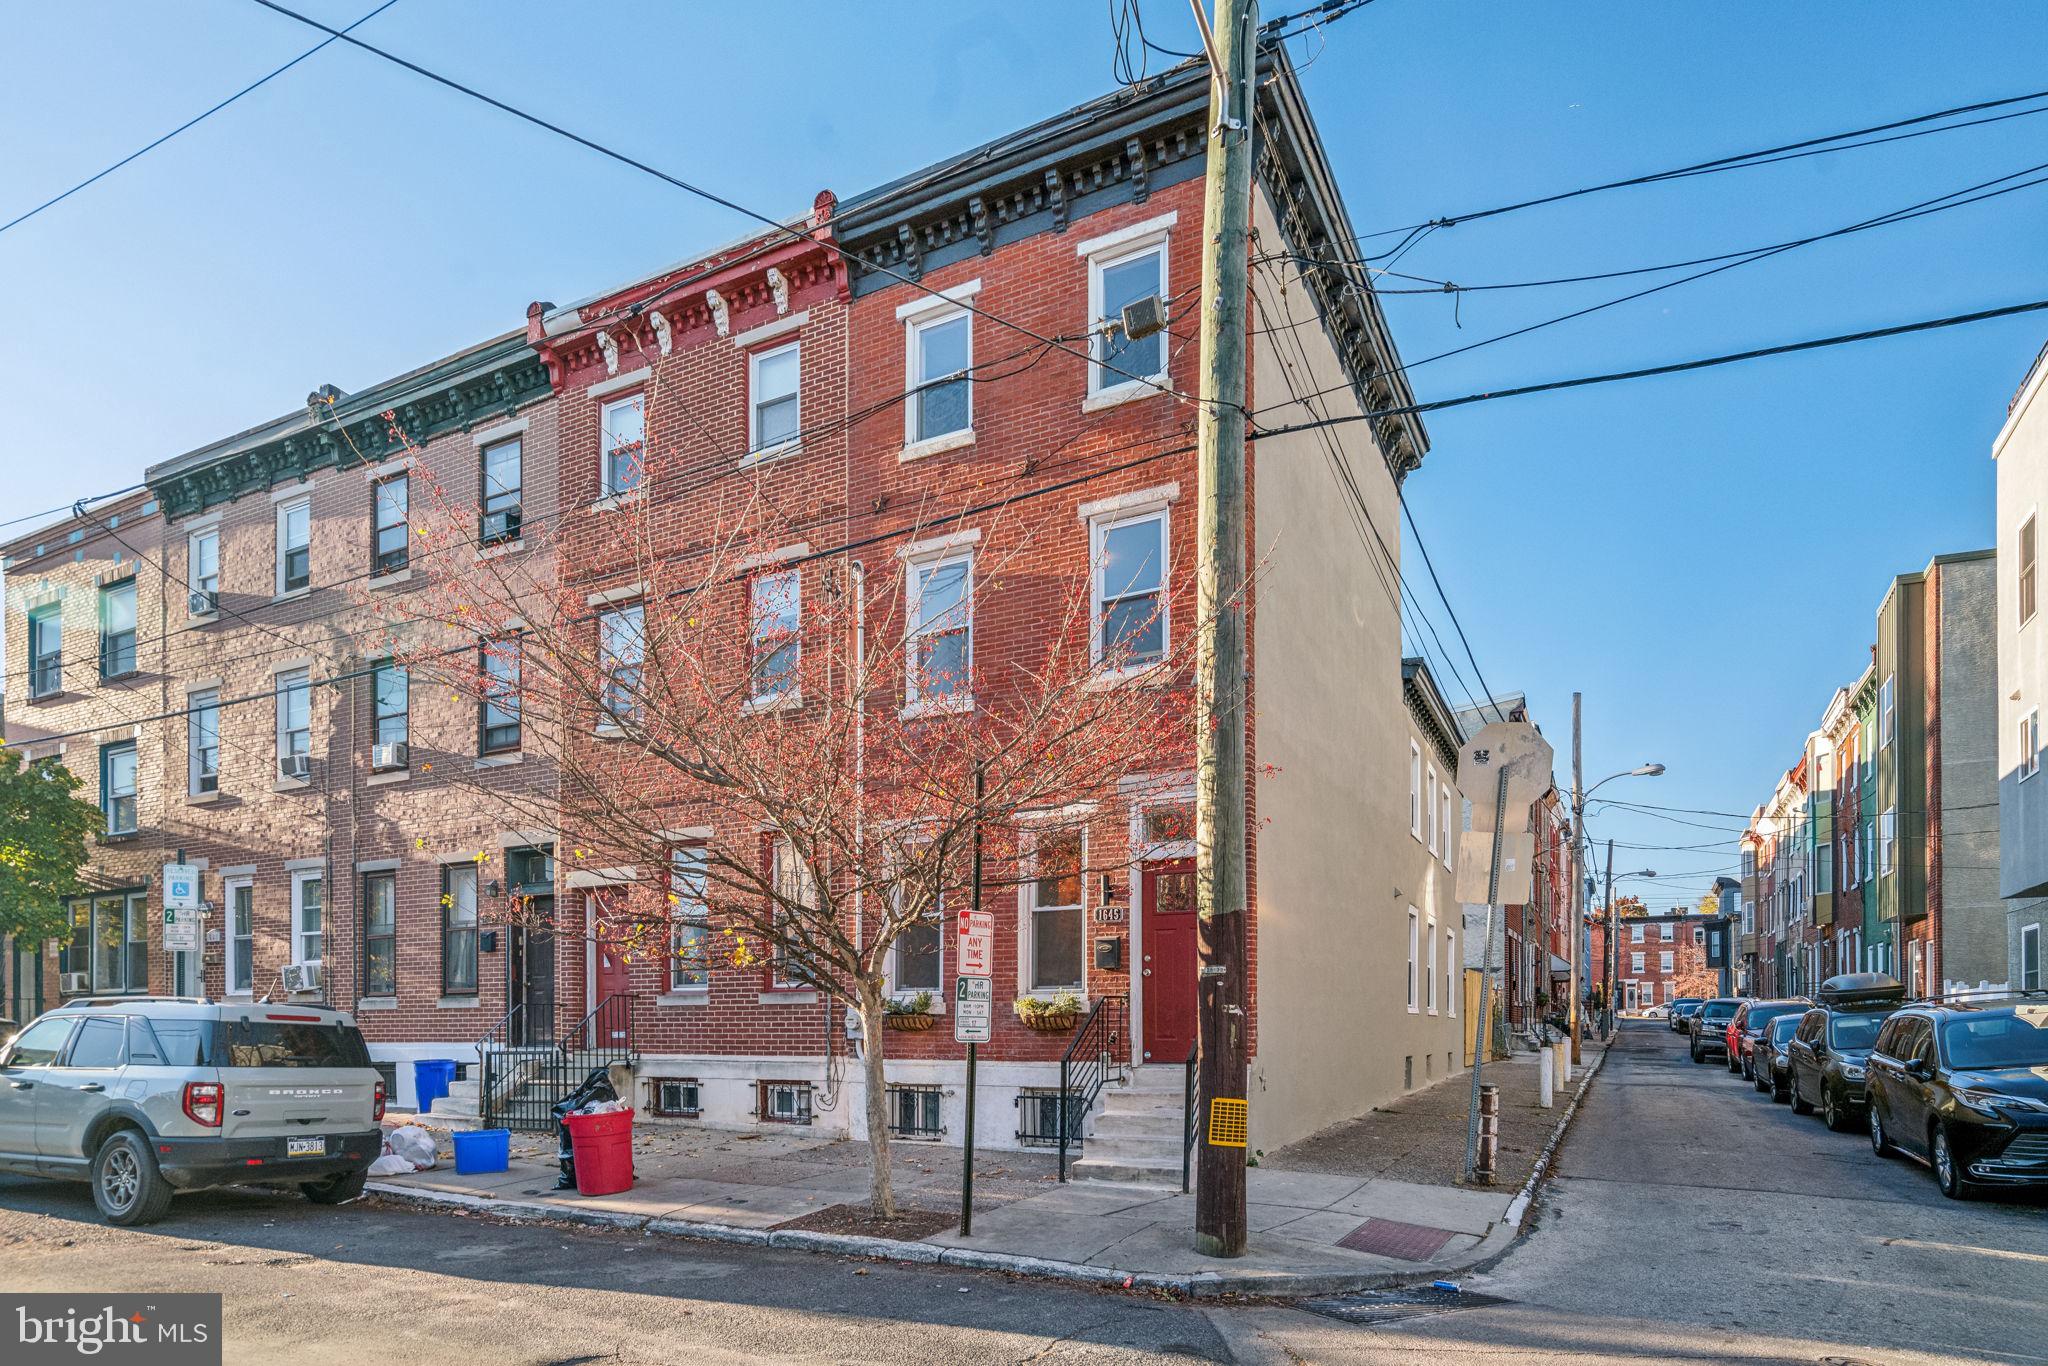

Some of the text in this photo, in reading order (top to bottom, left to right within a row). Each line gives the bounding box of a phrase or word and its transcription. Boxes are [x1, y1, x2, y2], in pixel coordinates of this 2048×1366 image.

[166, 911, 173, 922] 2
[1098, 908, 1119, 920] 1645
[960, 916, 991, 930] NO PARKING
[968, 936, 983, 948] ANY
[966, 948, 983, 960] TIME
[959, 981, 966, 998] 2
[974, 981, 984, 990] HR
[967, 990, 989, 1000] PARKING
